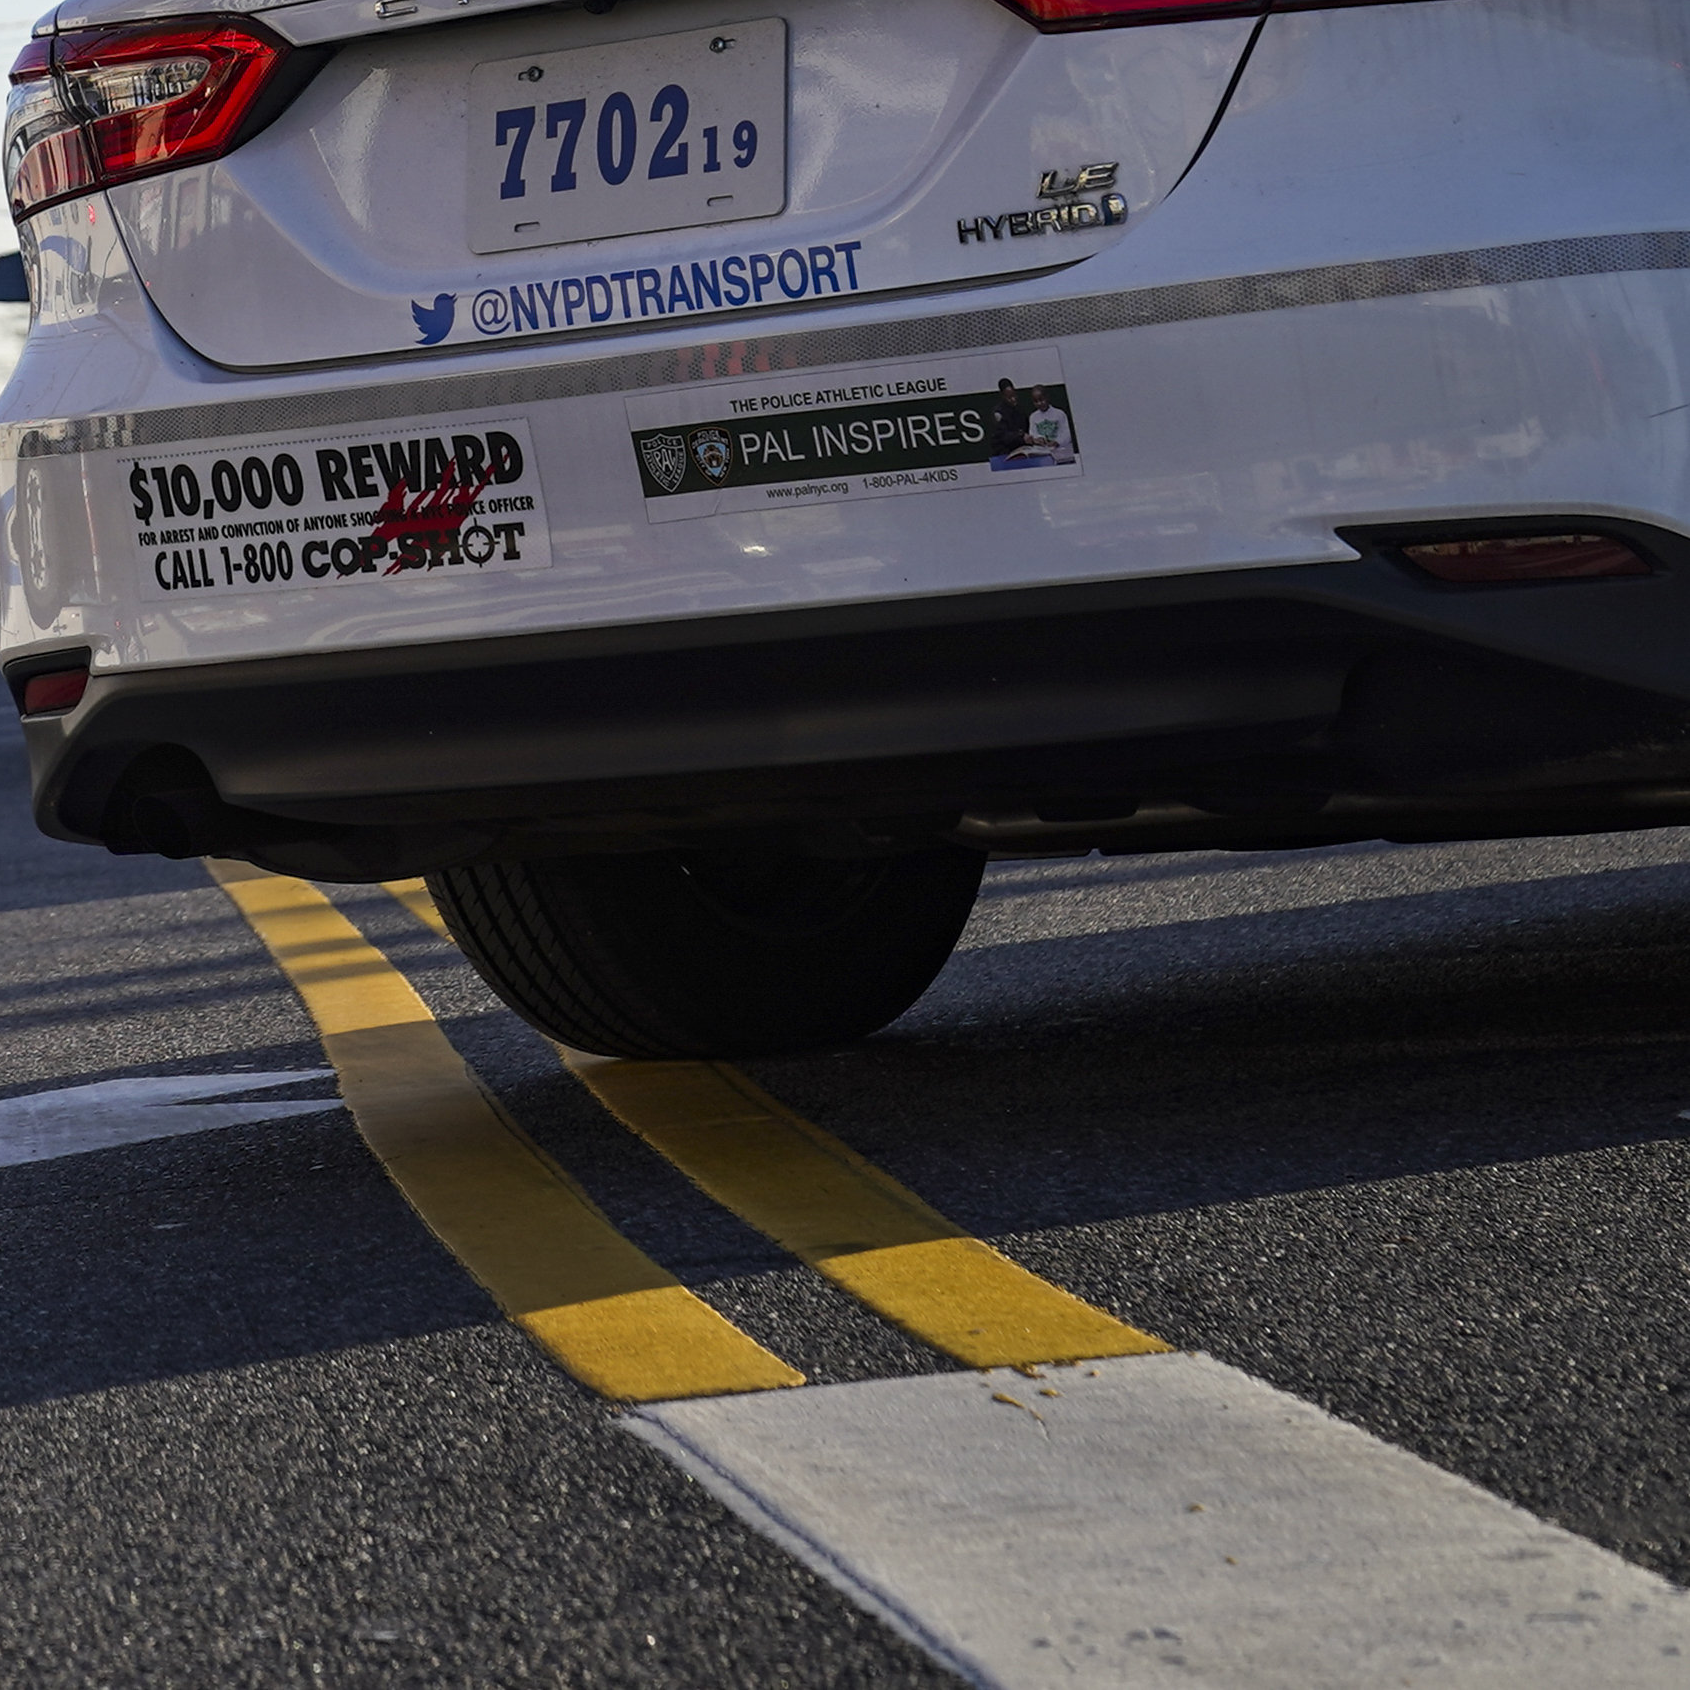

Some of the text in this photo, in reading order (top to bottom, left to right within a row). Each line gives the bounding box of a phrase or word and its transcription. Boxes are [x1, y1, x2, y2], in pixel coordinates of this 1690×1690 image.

[1036, 161, 1120, 200] LE
[957, 201, 1101, 245] HYBRID
[471, 241, 863, 336] @NYPDTRANSPORT
[729, 377, 948, 414] THE POLICE ATHLETIC LEAGUE
[739, 429, 805, 466] PAL
[811, 409, 986, 459] INSPIRES
[129, 431, 524, 527] $10,000 REWARD
[766, 468, 958, 500] www.palnyc.org 1-800-PAL-4KIDS
[138, 531, 157, 546] FOR
[159, 528, 195, 545] ARREST
[198, 525, 219, 542] AND
[221, 519, 284, 539] CONVICTION
[286, 518, 300, 532] OF
[303, 513, 348, 531] ANYONE
[447, 501, 485, 518] POLICE
[488, 495, 534, 514] OFFICER
[155, 548, 215, 591] CALL
[220, 540, 294, 586] 1-800
